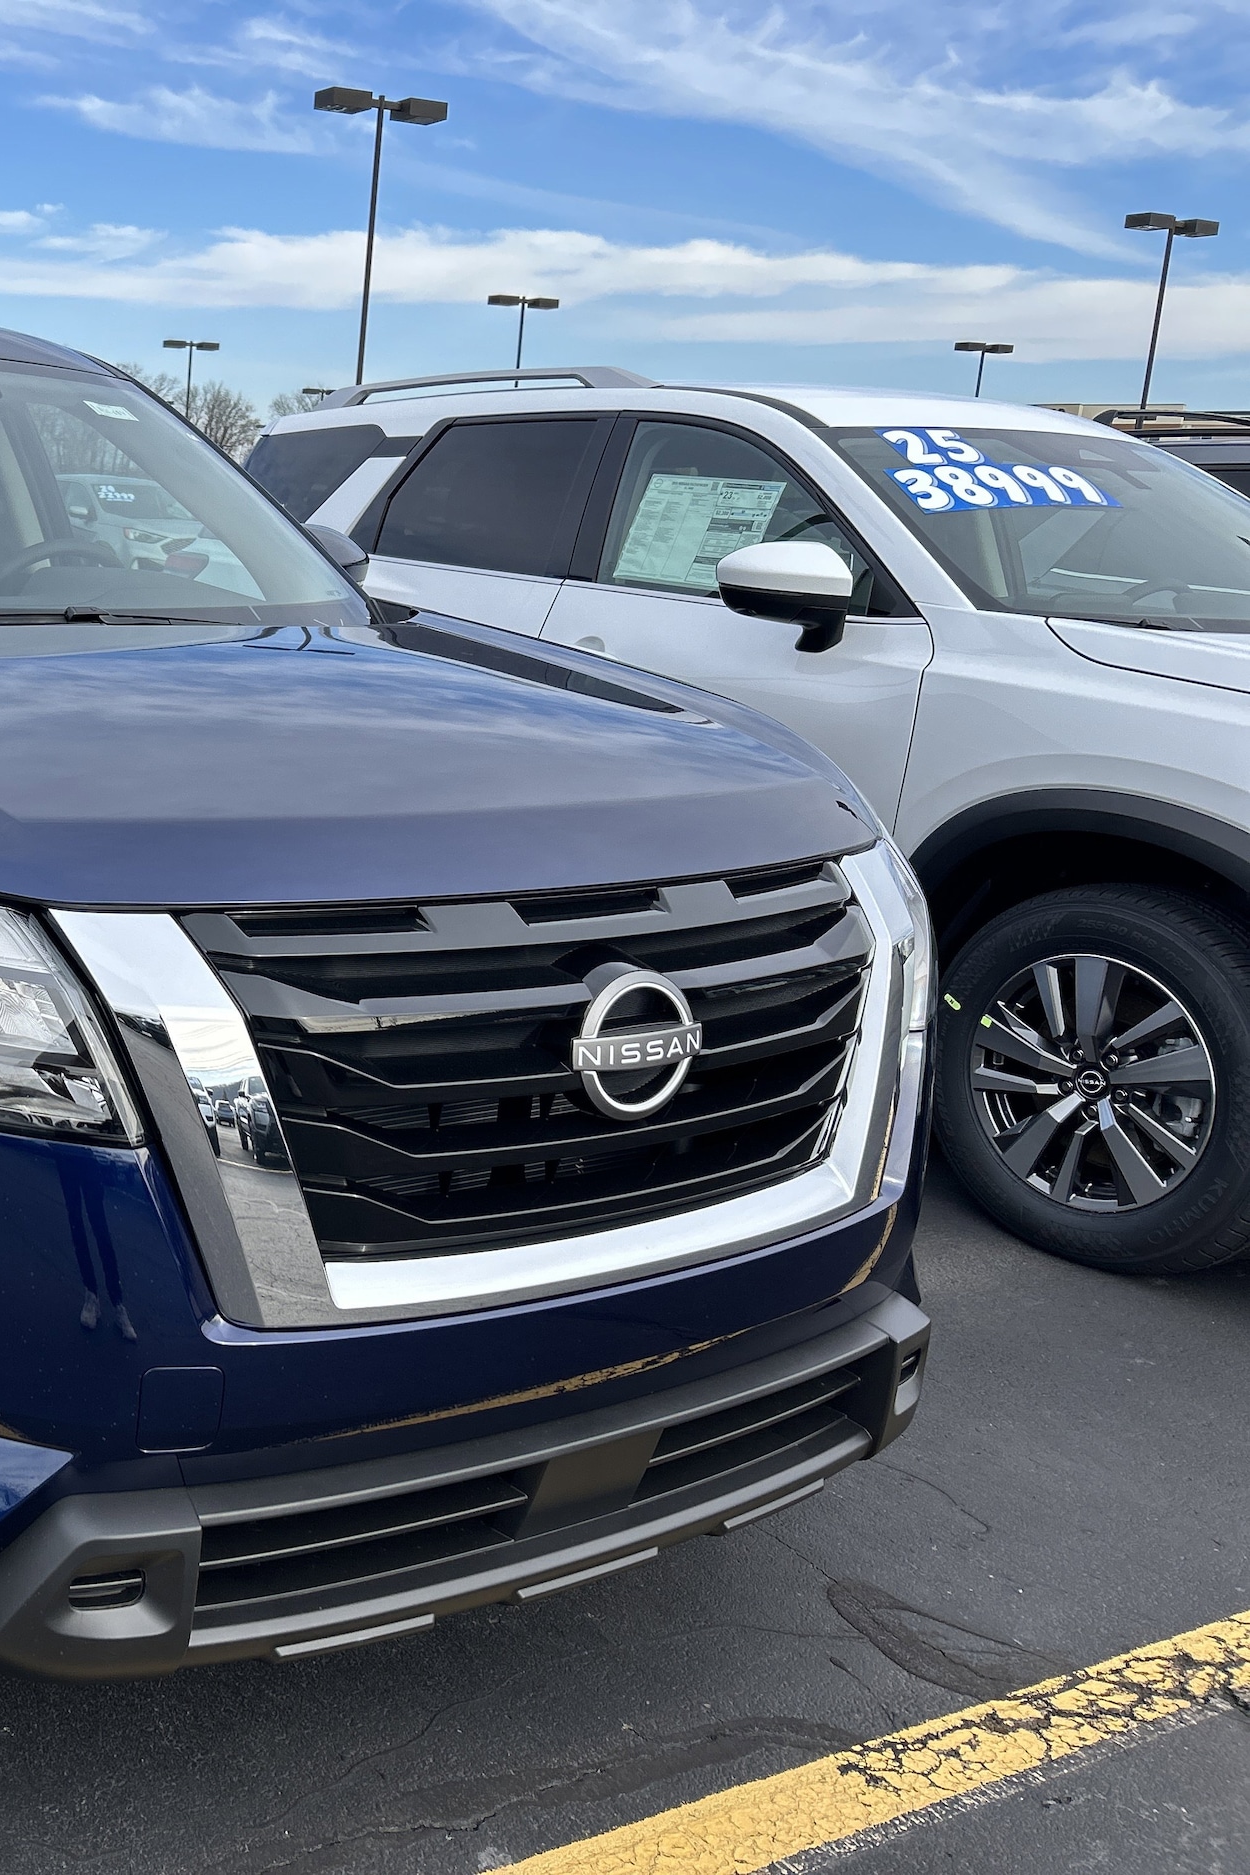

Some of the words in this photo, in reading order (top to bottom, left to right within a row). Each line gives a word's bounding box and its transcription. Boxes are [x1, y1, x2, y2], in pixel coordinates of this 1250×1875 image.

[881, 428, 986, 465] 25
[892, 465, 1109, 511] 38999
[577, 1029, 700, 1067] NISSAN
[1147, 1177, 1230, 1245] KUMHO
